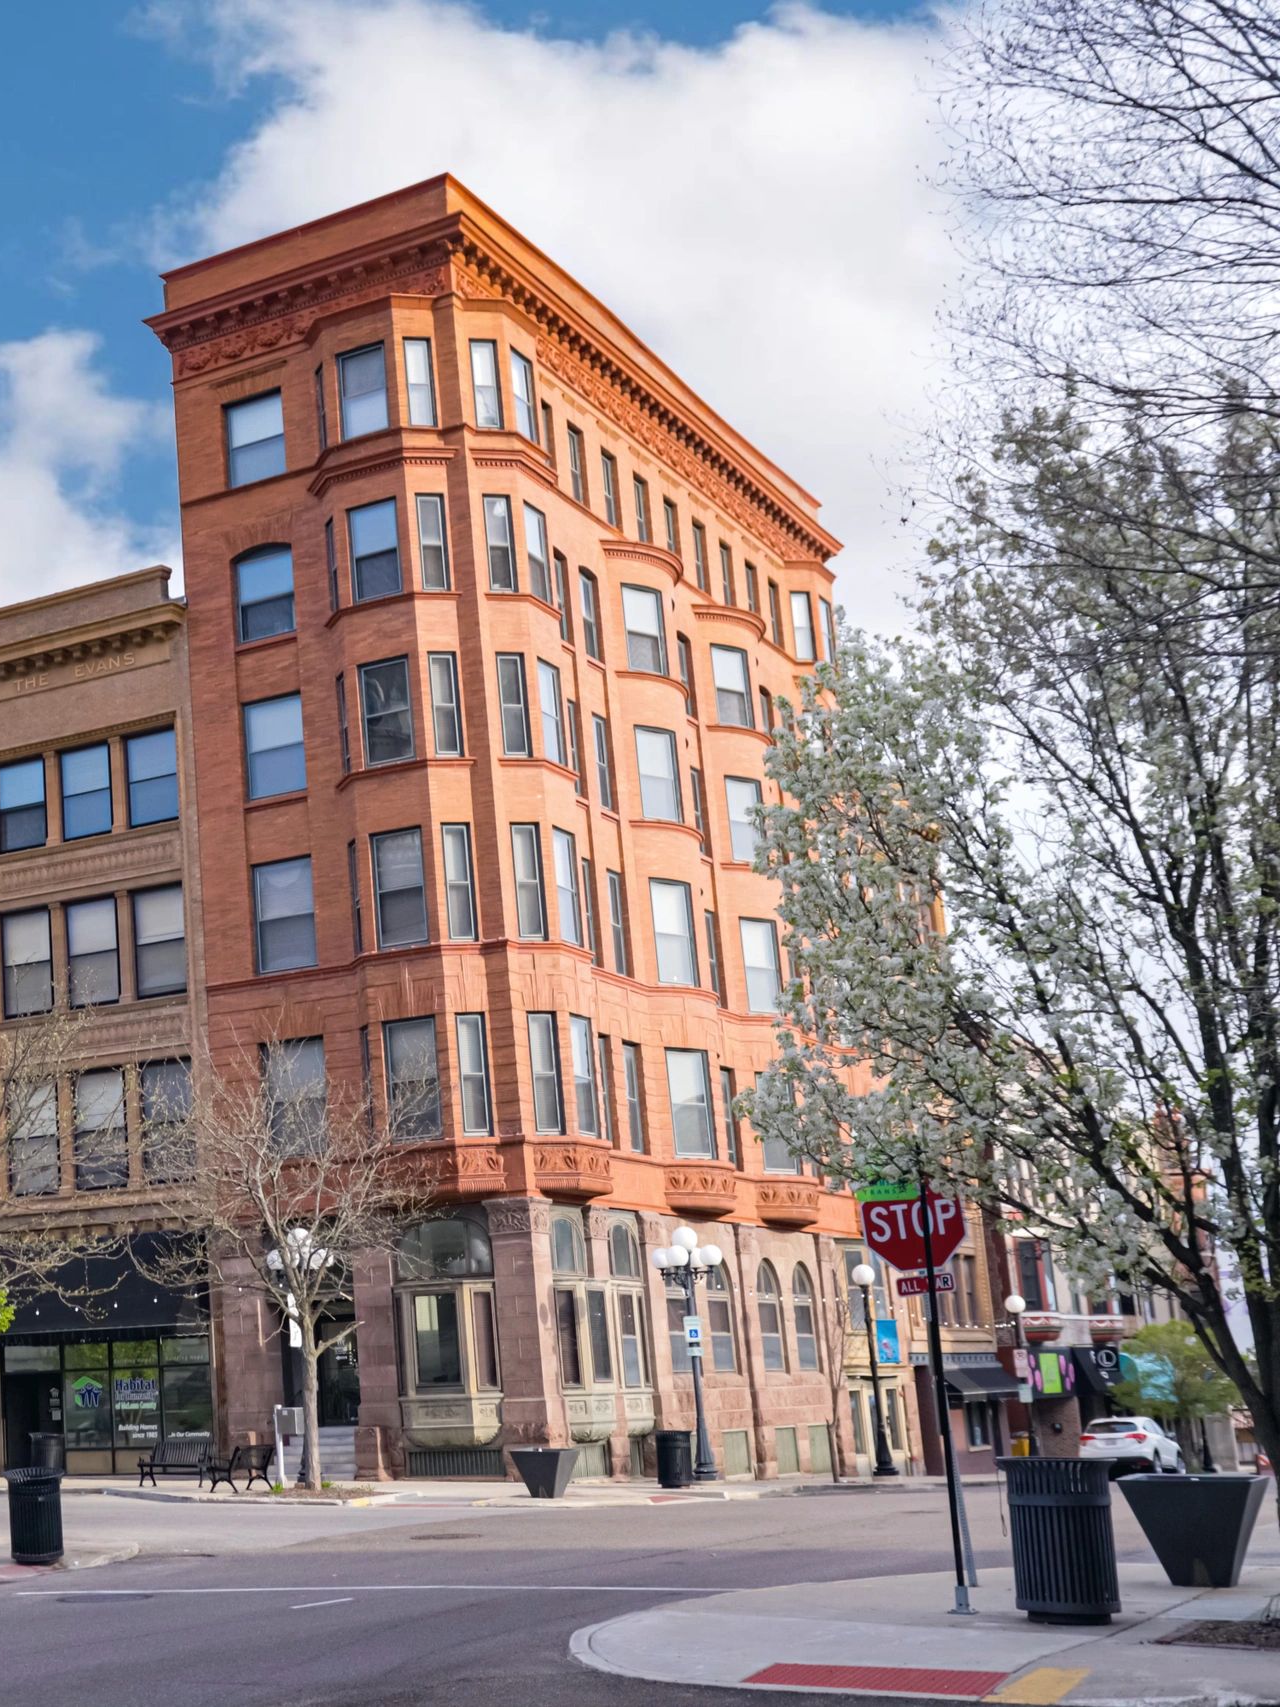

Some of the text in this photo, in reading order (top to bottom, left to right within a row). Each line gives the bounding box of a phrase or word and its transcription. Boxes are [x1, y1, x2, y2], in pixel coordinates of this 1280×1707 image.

[14, 652, 135, 692] THE EVANS
[870, 1199, 956, 1243] STOP
[901, 1280, 921, 1293] ALL
[115, 1378, 156, 1391] Habitat
[118, 1424, 139, 1432] Building
